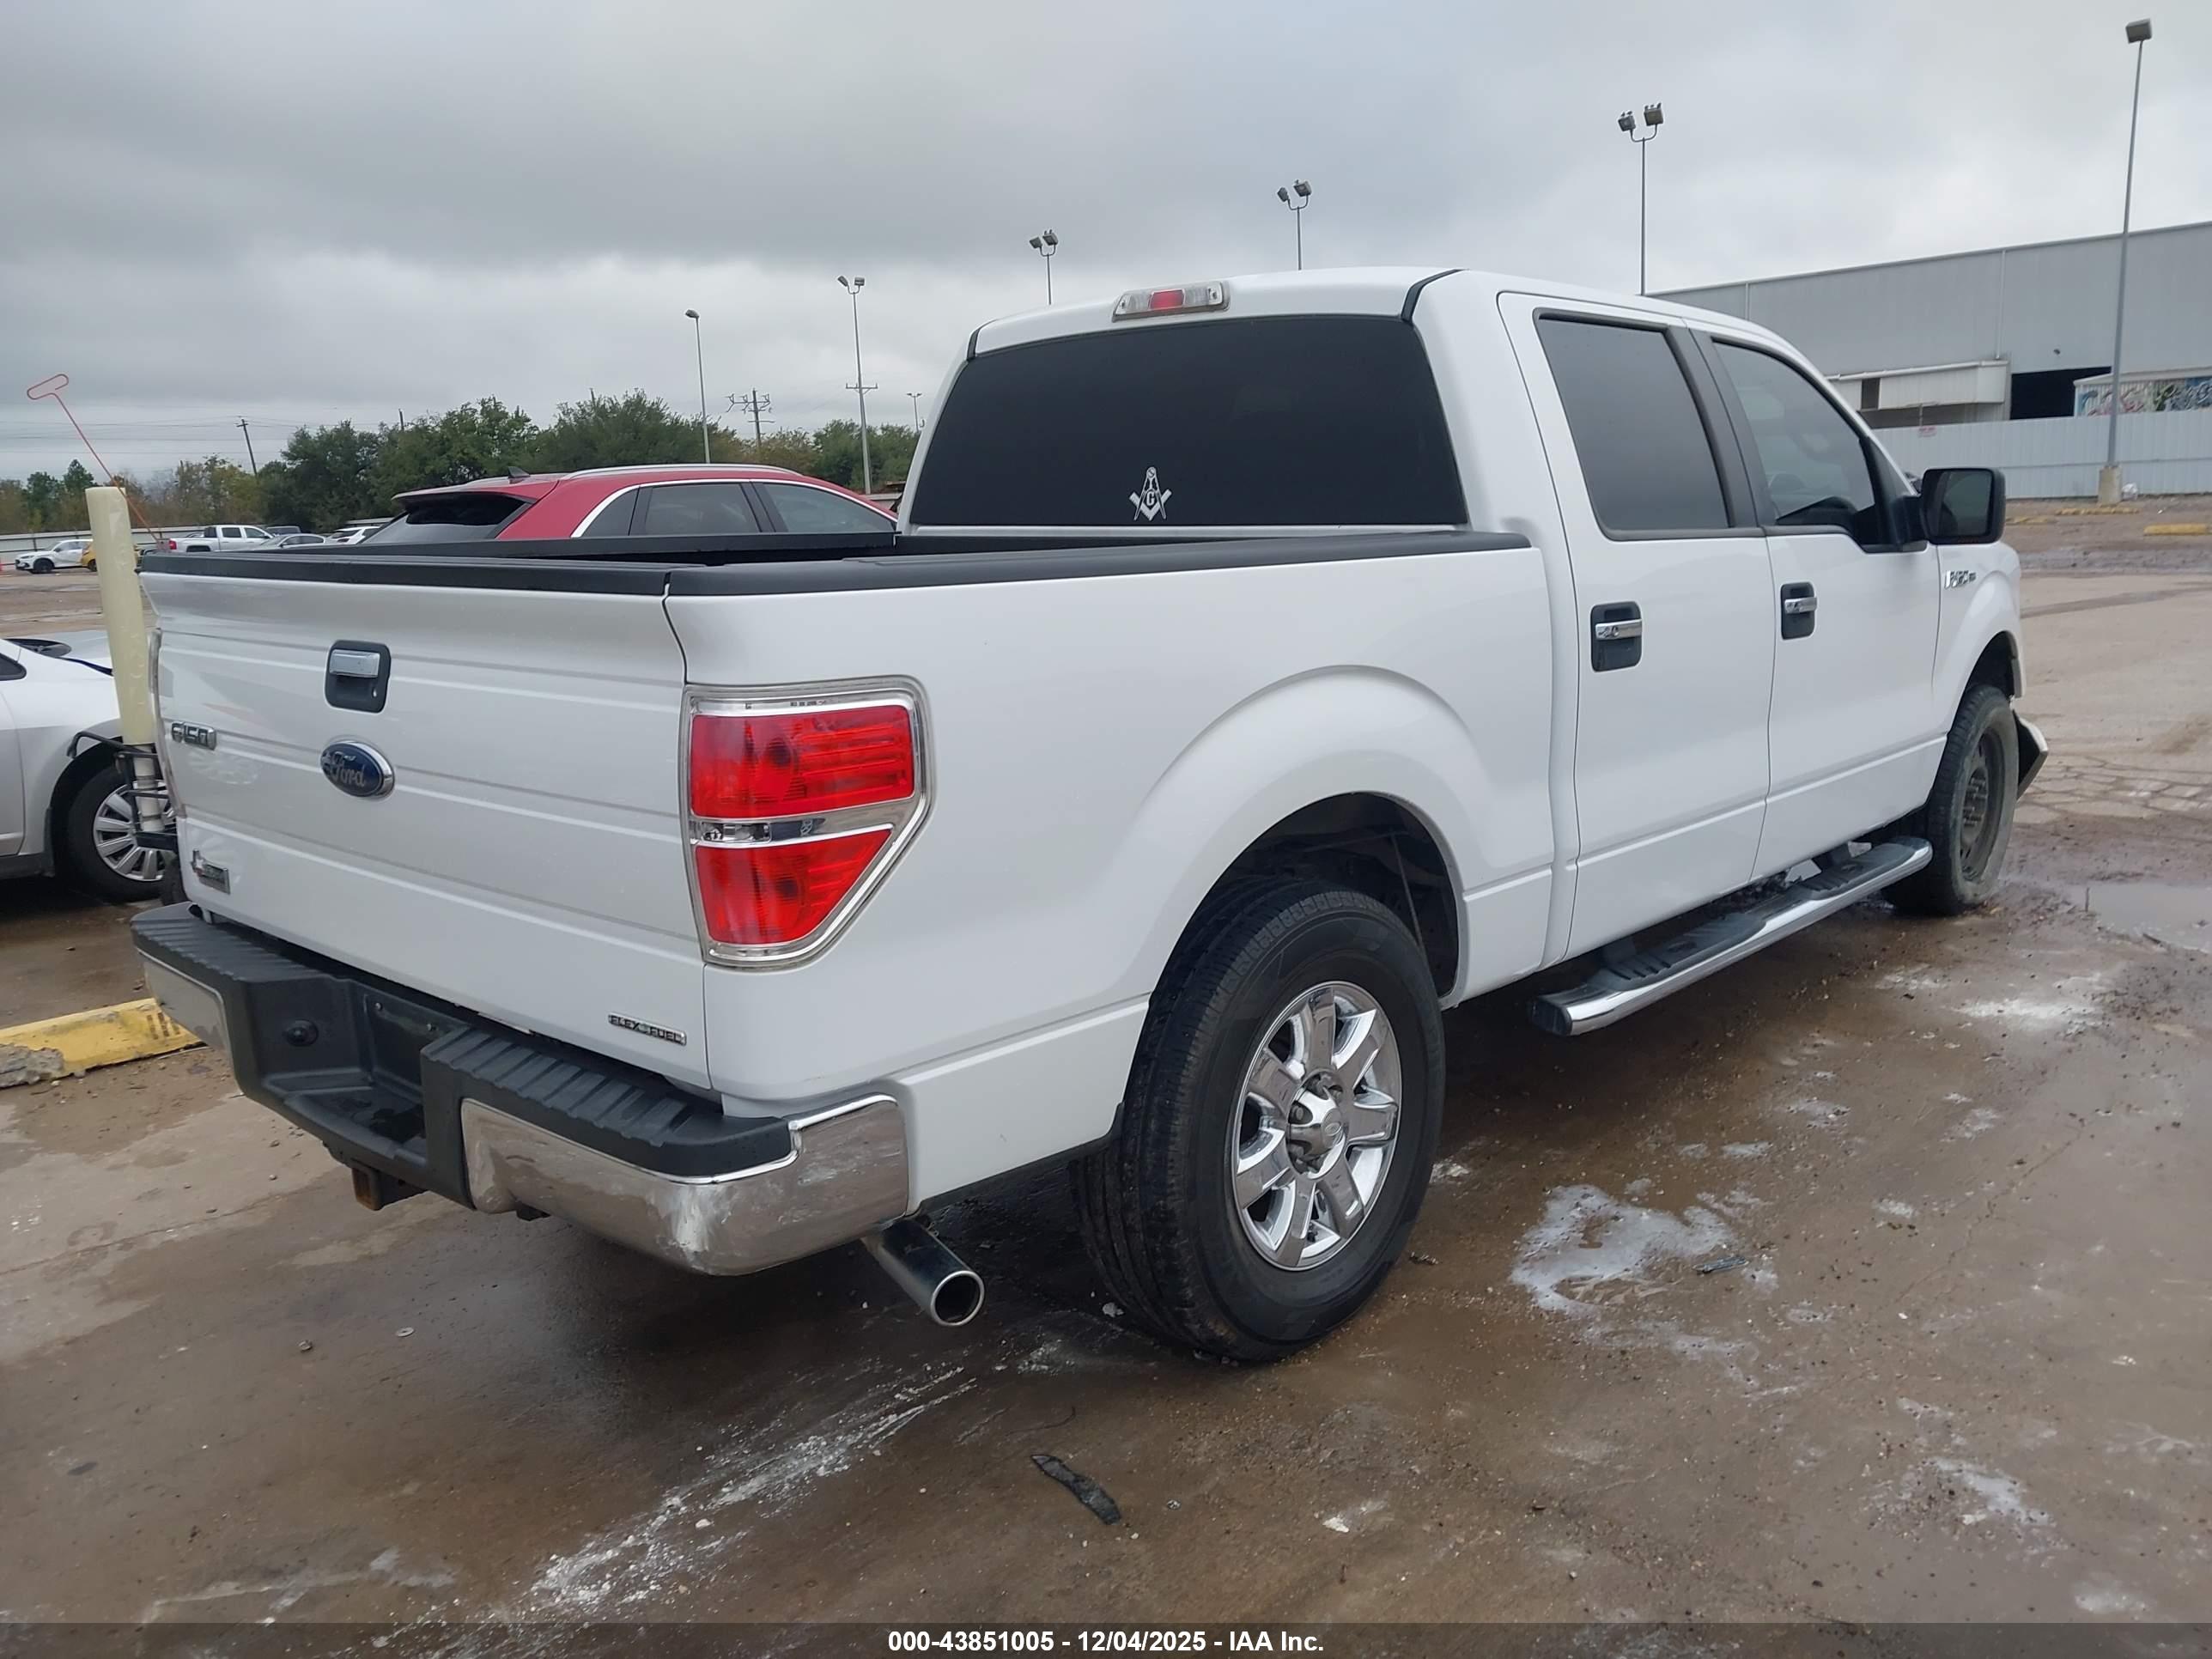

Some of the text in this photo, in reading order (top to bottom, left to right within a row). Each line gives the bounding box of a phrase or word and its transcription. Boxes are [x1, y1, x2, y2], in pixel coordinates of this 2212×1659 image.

[323, 750, 367, 787] Ford
[608, 1013, 685, 1045] FLEX FUEL
